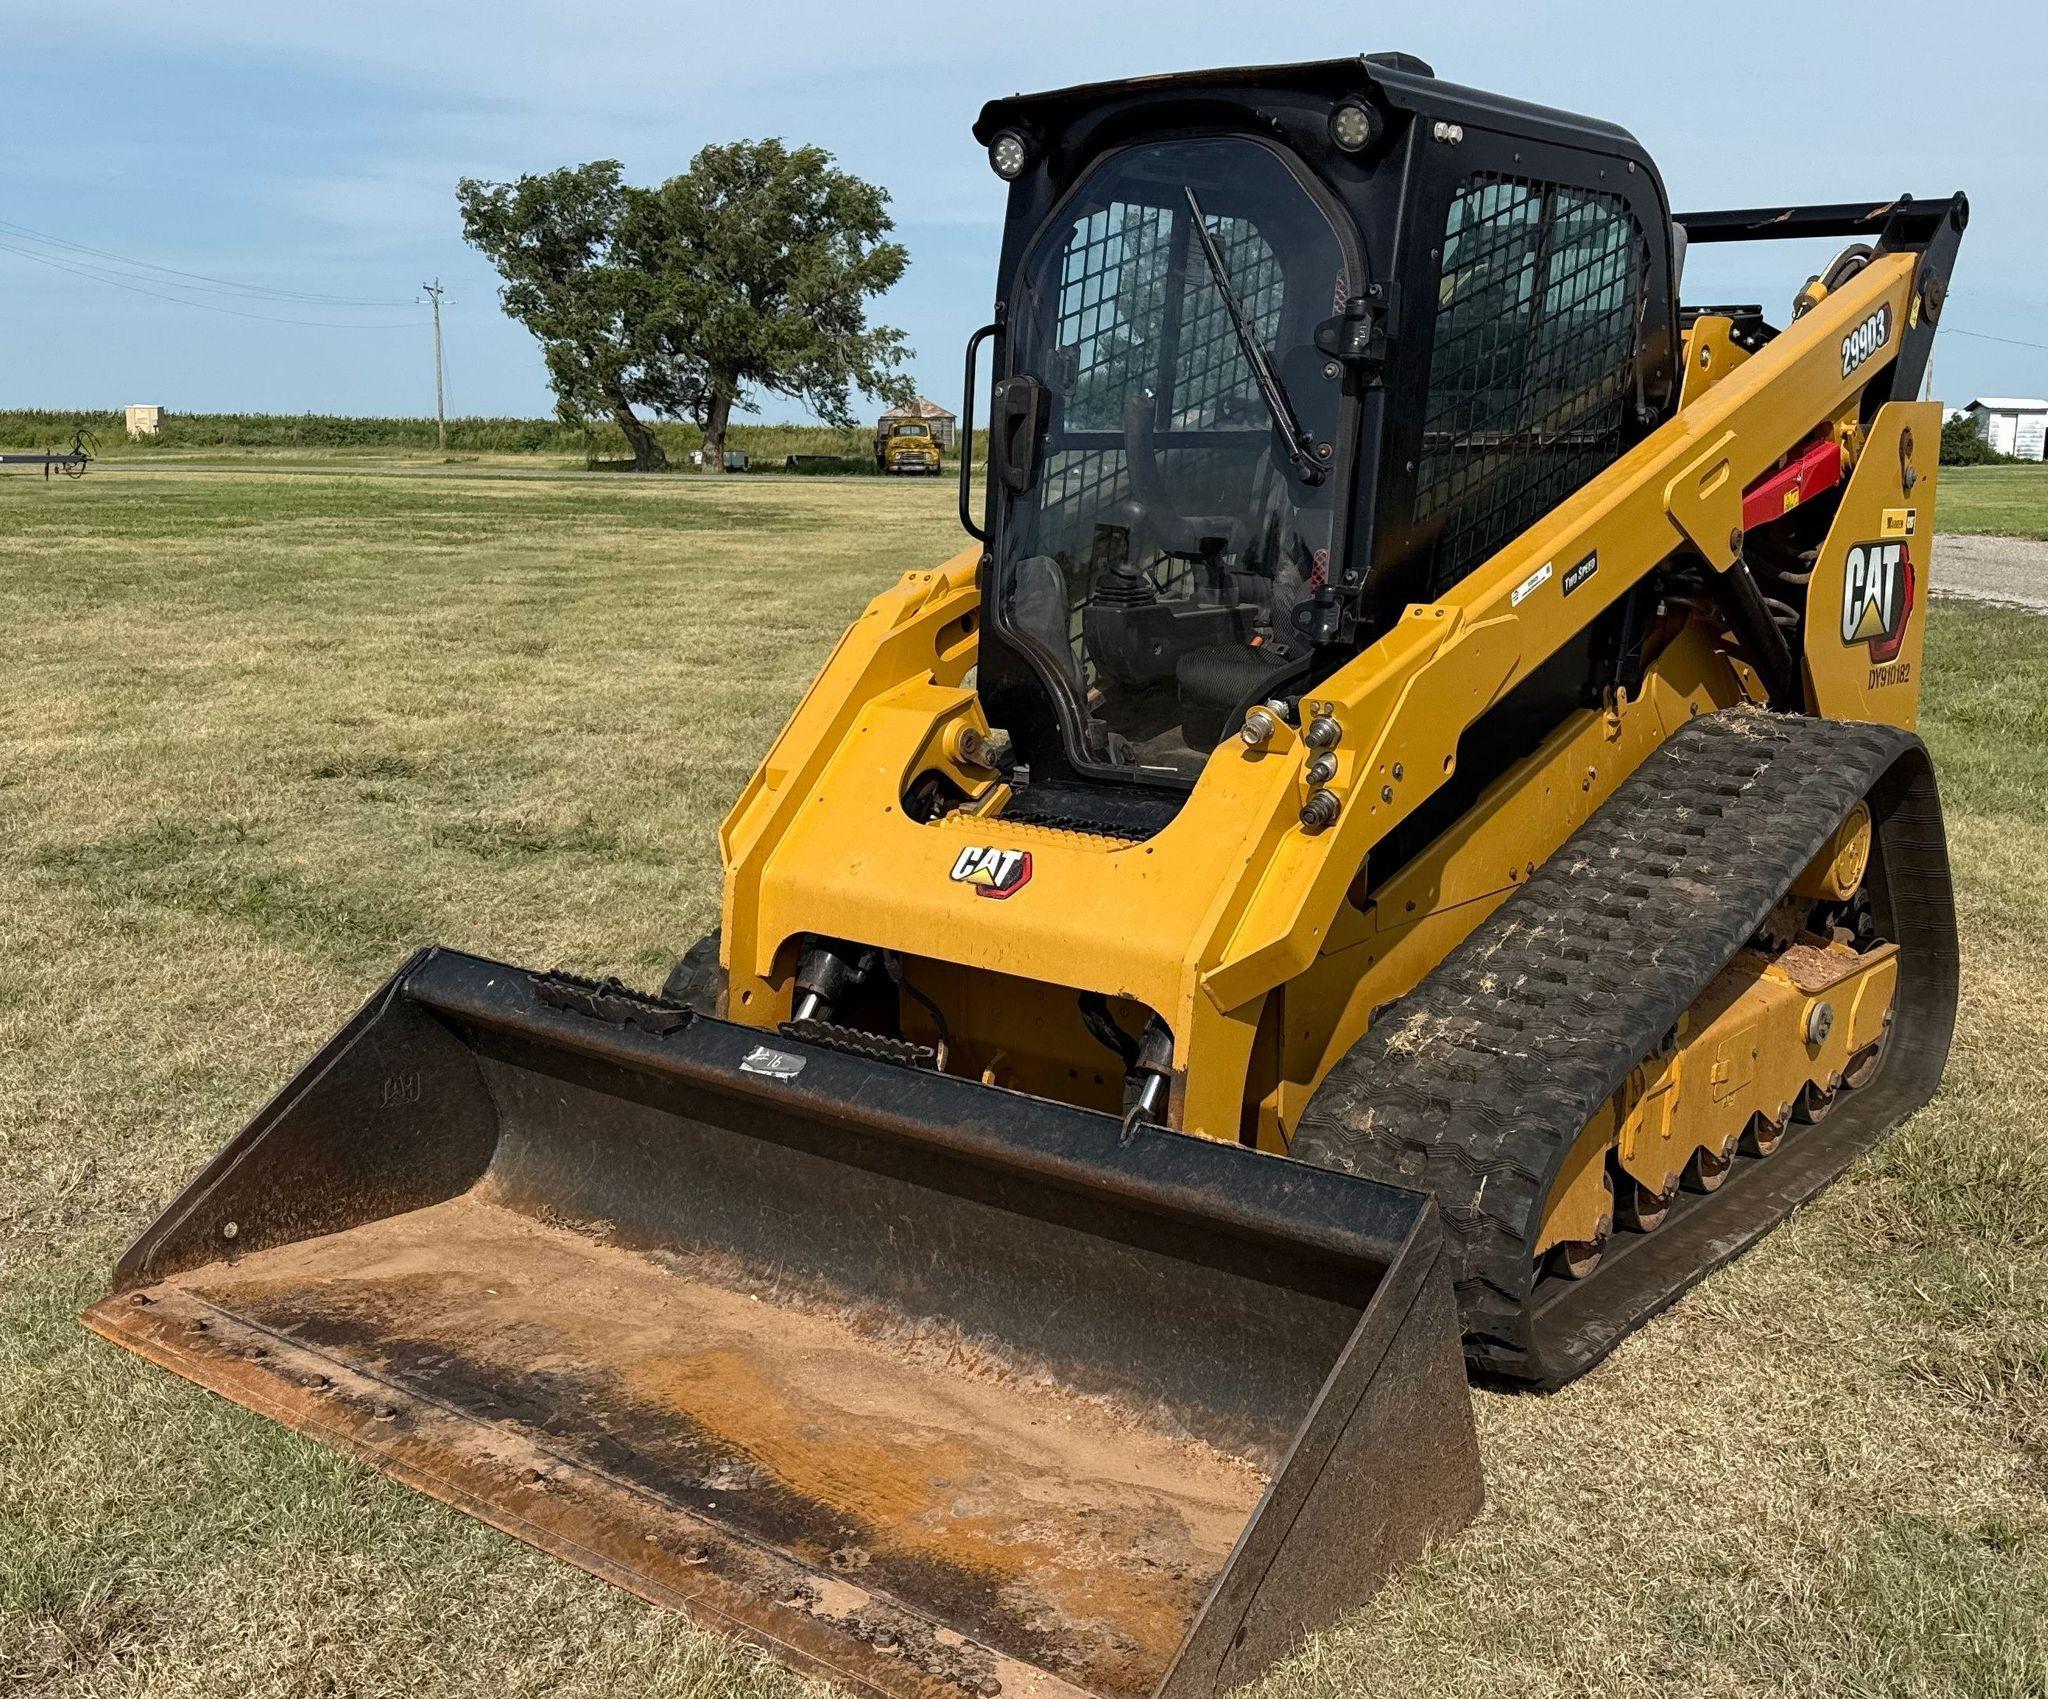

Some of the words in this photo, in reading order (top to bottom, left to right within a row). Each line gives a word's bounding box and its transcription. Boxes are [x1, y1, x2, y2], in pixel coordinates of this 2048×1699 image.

[1841, 308, 1885, 377] 299D3
[1843, 545, 1900, 641] CAT
[1868, 663, 1910, 690] DY910182
[951, 846, 1023, 887] CAT
